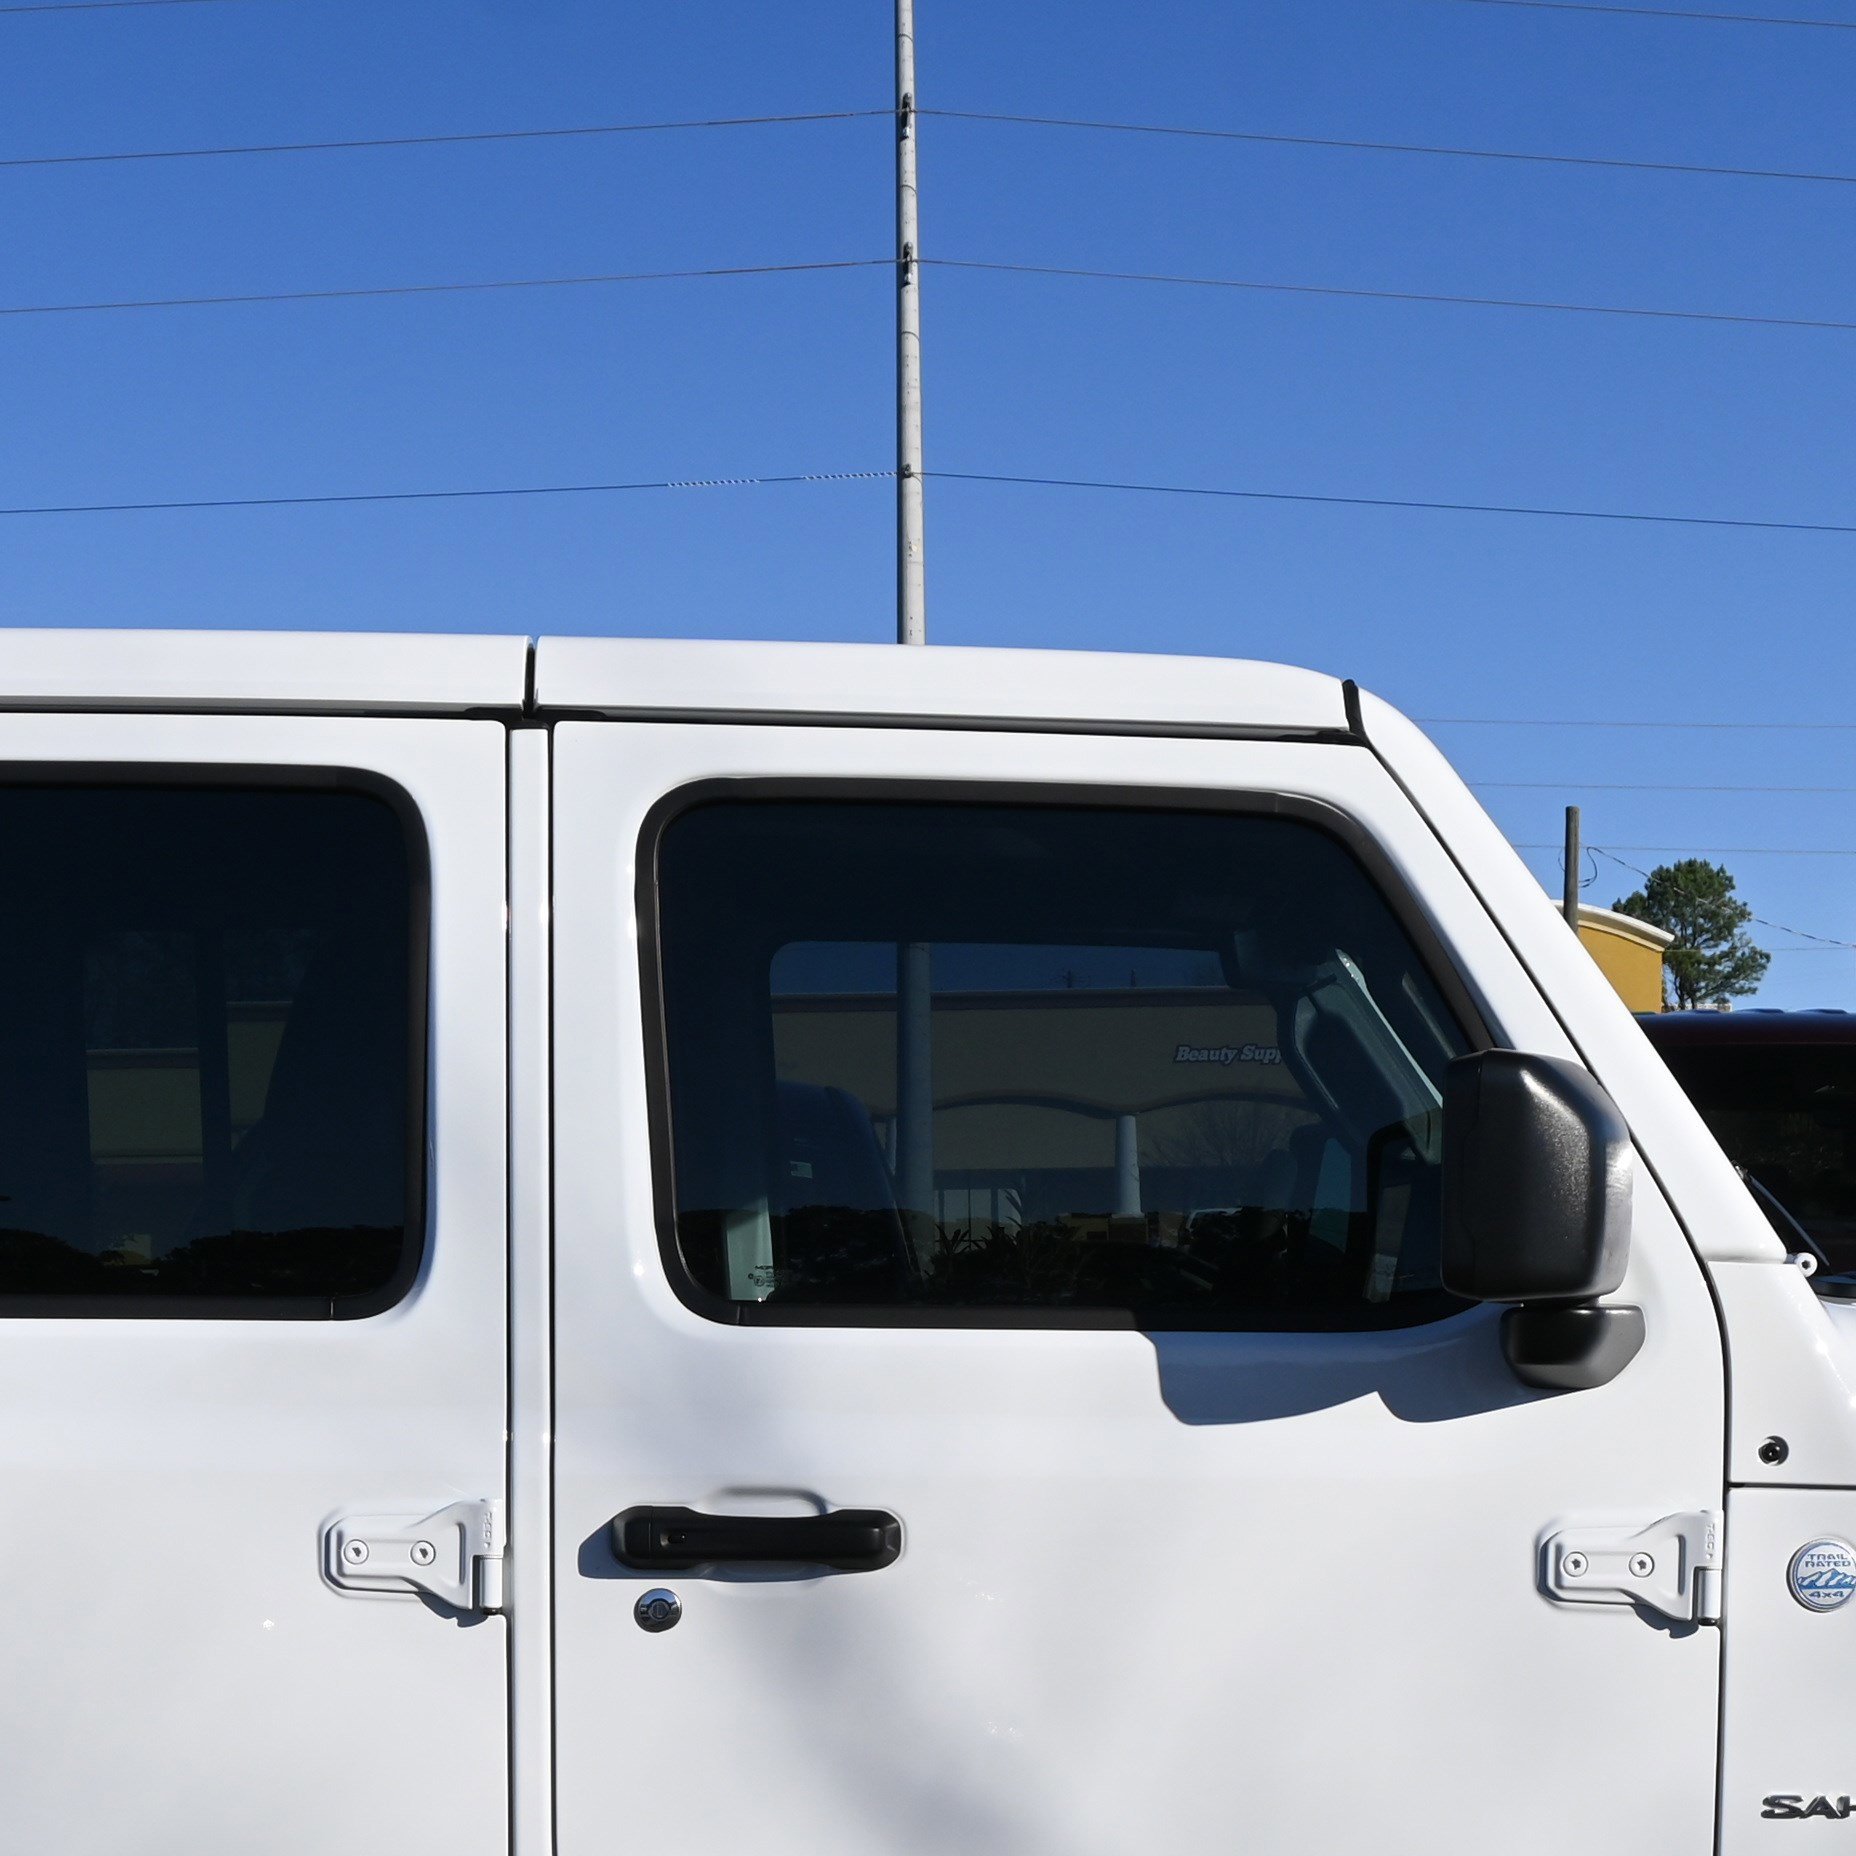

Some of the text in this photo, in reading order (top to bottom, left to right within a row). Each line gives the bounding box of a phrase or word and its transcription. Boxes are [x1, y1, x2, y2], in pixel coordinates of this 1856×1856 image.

[1175, 1044, 1239, 1066] Beauty
[1807, 1553, 1848, 1561] TRAIL
[1804, 1560, 1852, 1568] RATED
[1808, 1590, 1845, 1598] 4x4
